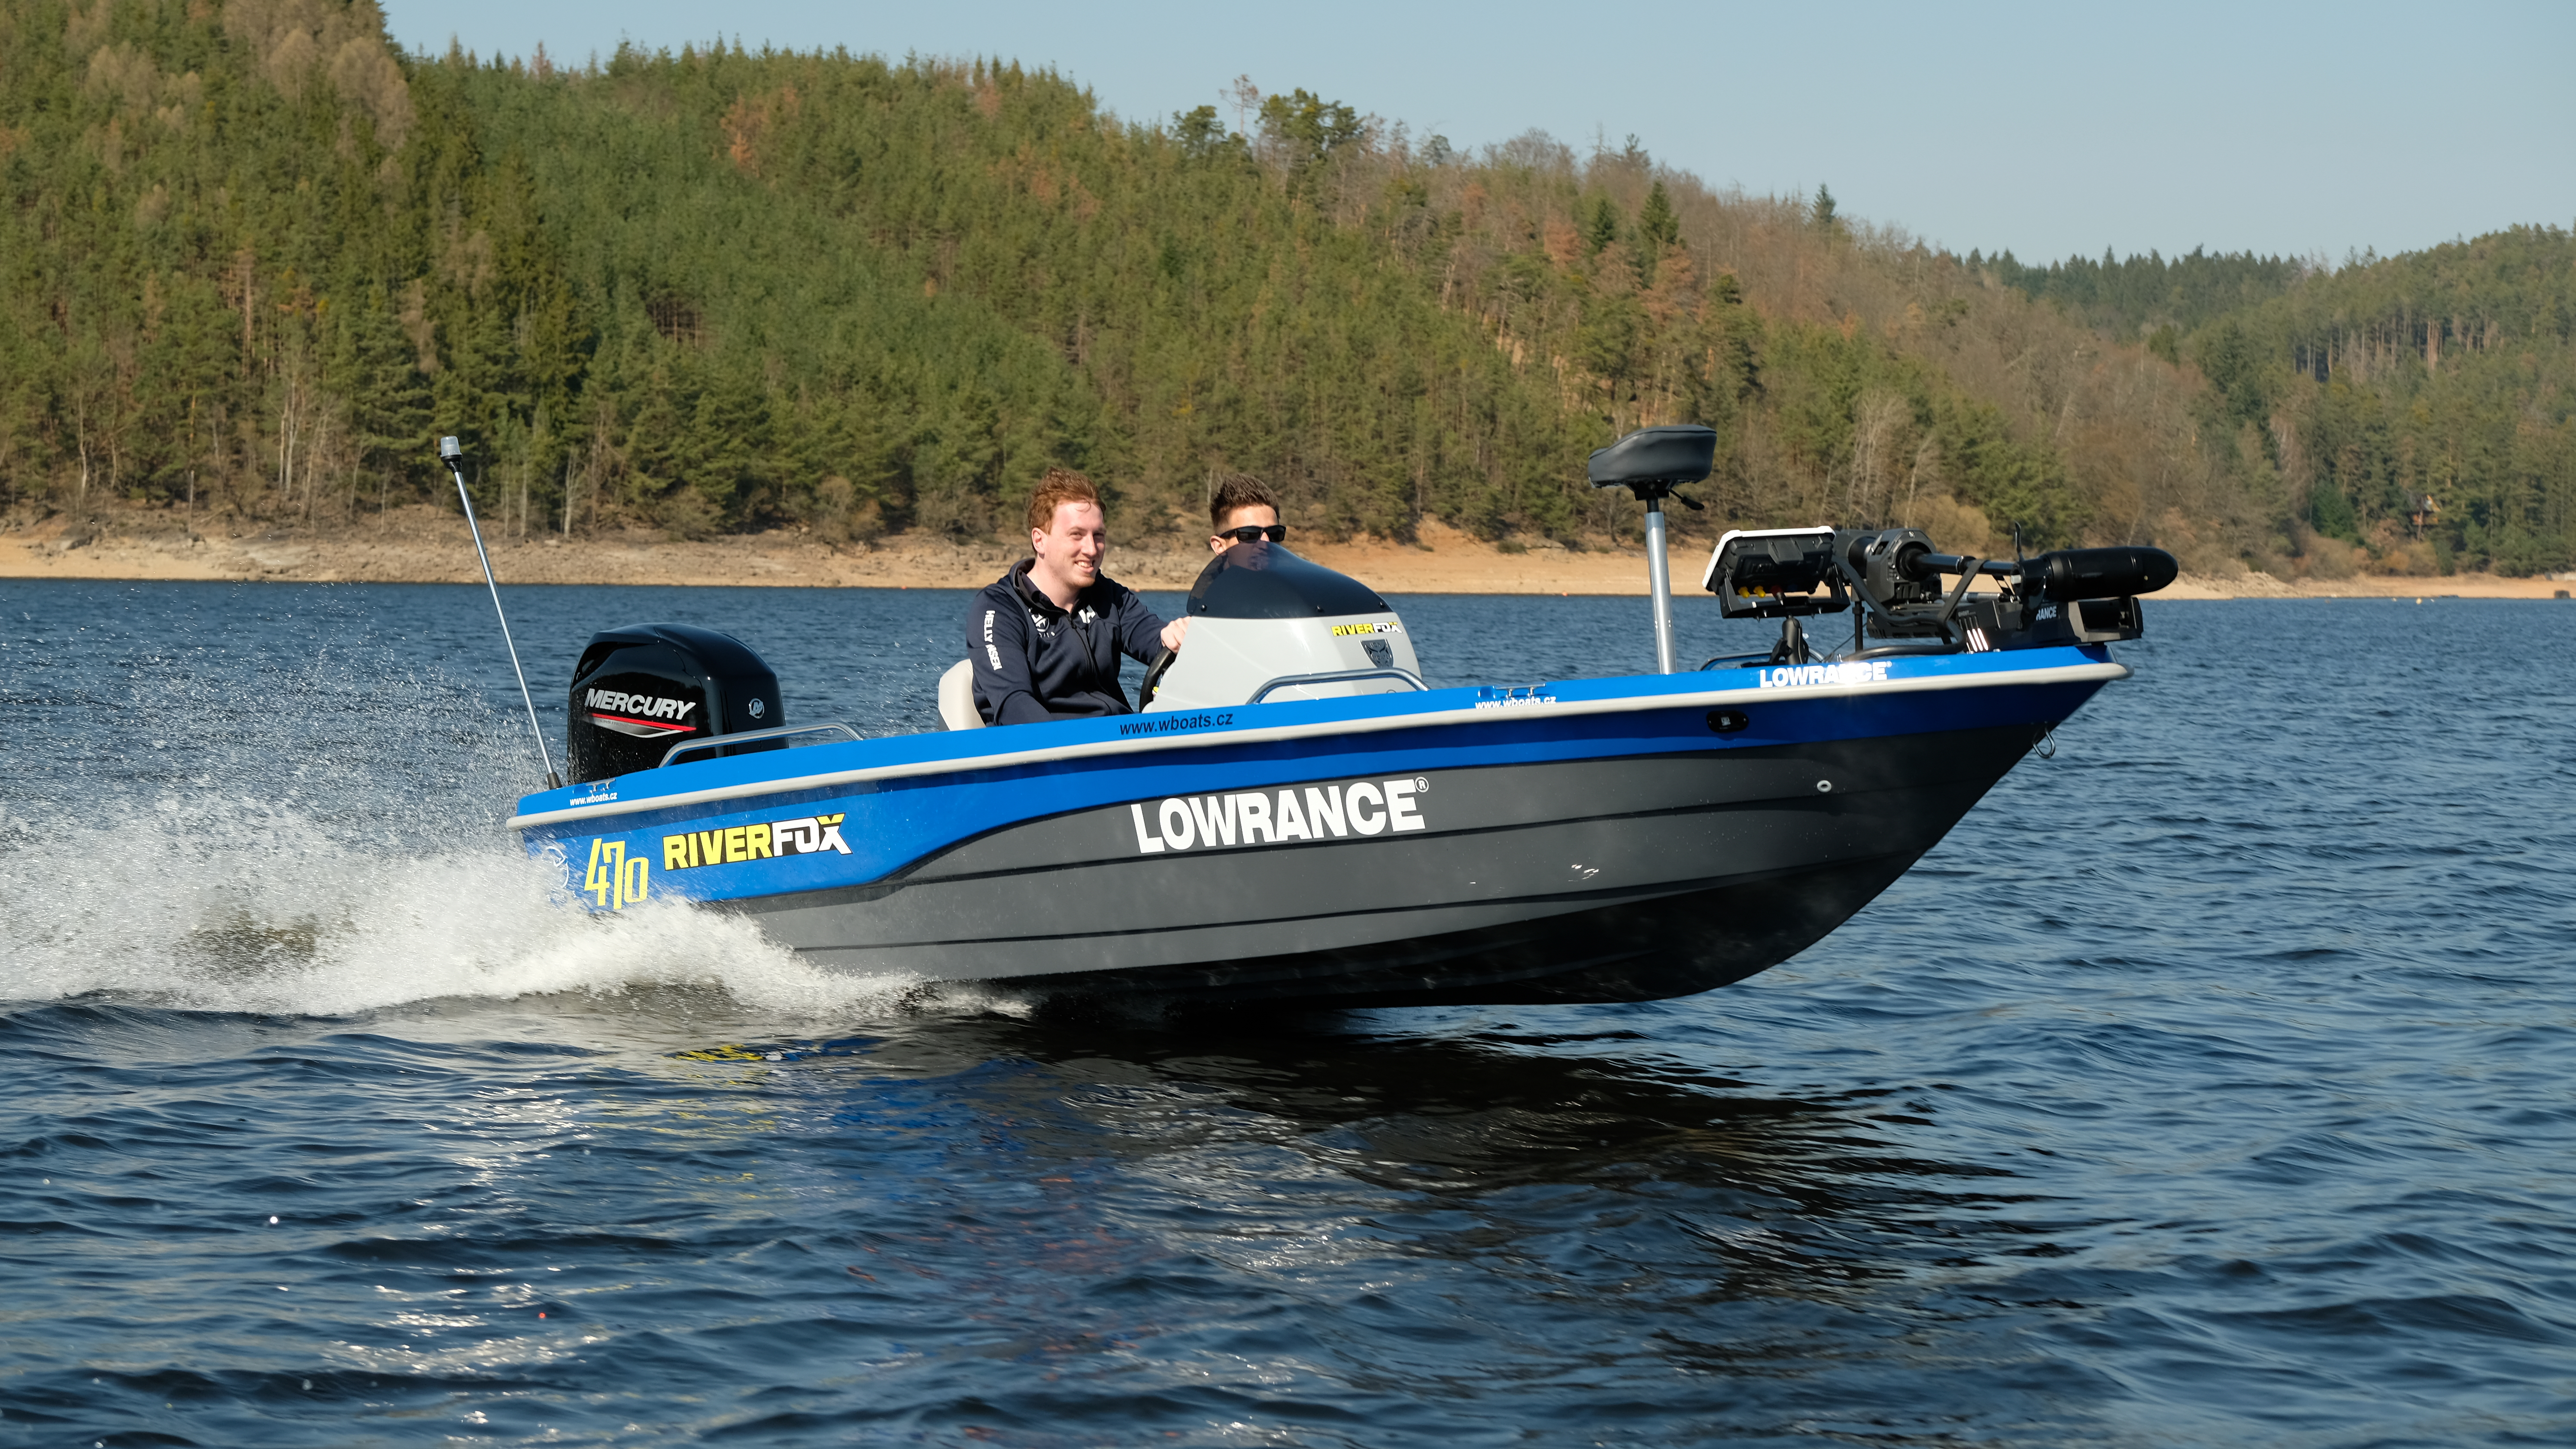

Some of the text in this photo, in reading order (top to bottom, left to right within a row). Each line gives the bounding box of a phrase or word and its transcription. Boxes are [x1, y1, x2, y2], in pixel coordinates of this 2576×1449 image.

[984, 610, 1002, 671] HELLY NSEN
[1331, 621, 1403, 637] RIVERFOX
[584, 688, 696, 720] MERCURY
[1475, 696, 1556, 709] www.wboats.cz
[1120, 713, 1233, 735] www.wboats.cz
[569, 792, 618, 806] www.wboats.cz
[662, 813, 853, 871] RIVERFOX
[584, 838, 649, 909] 470
